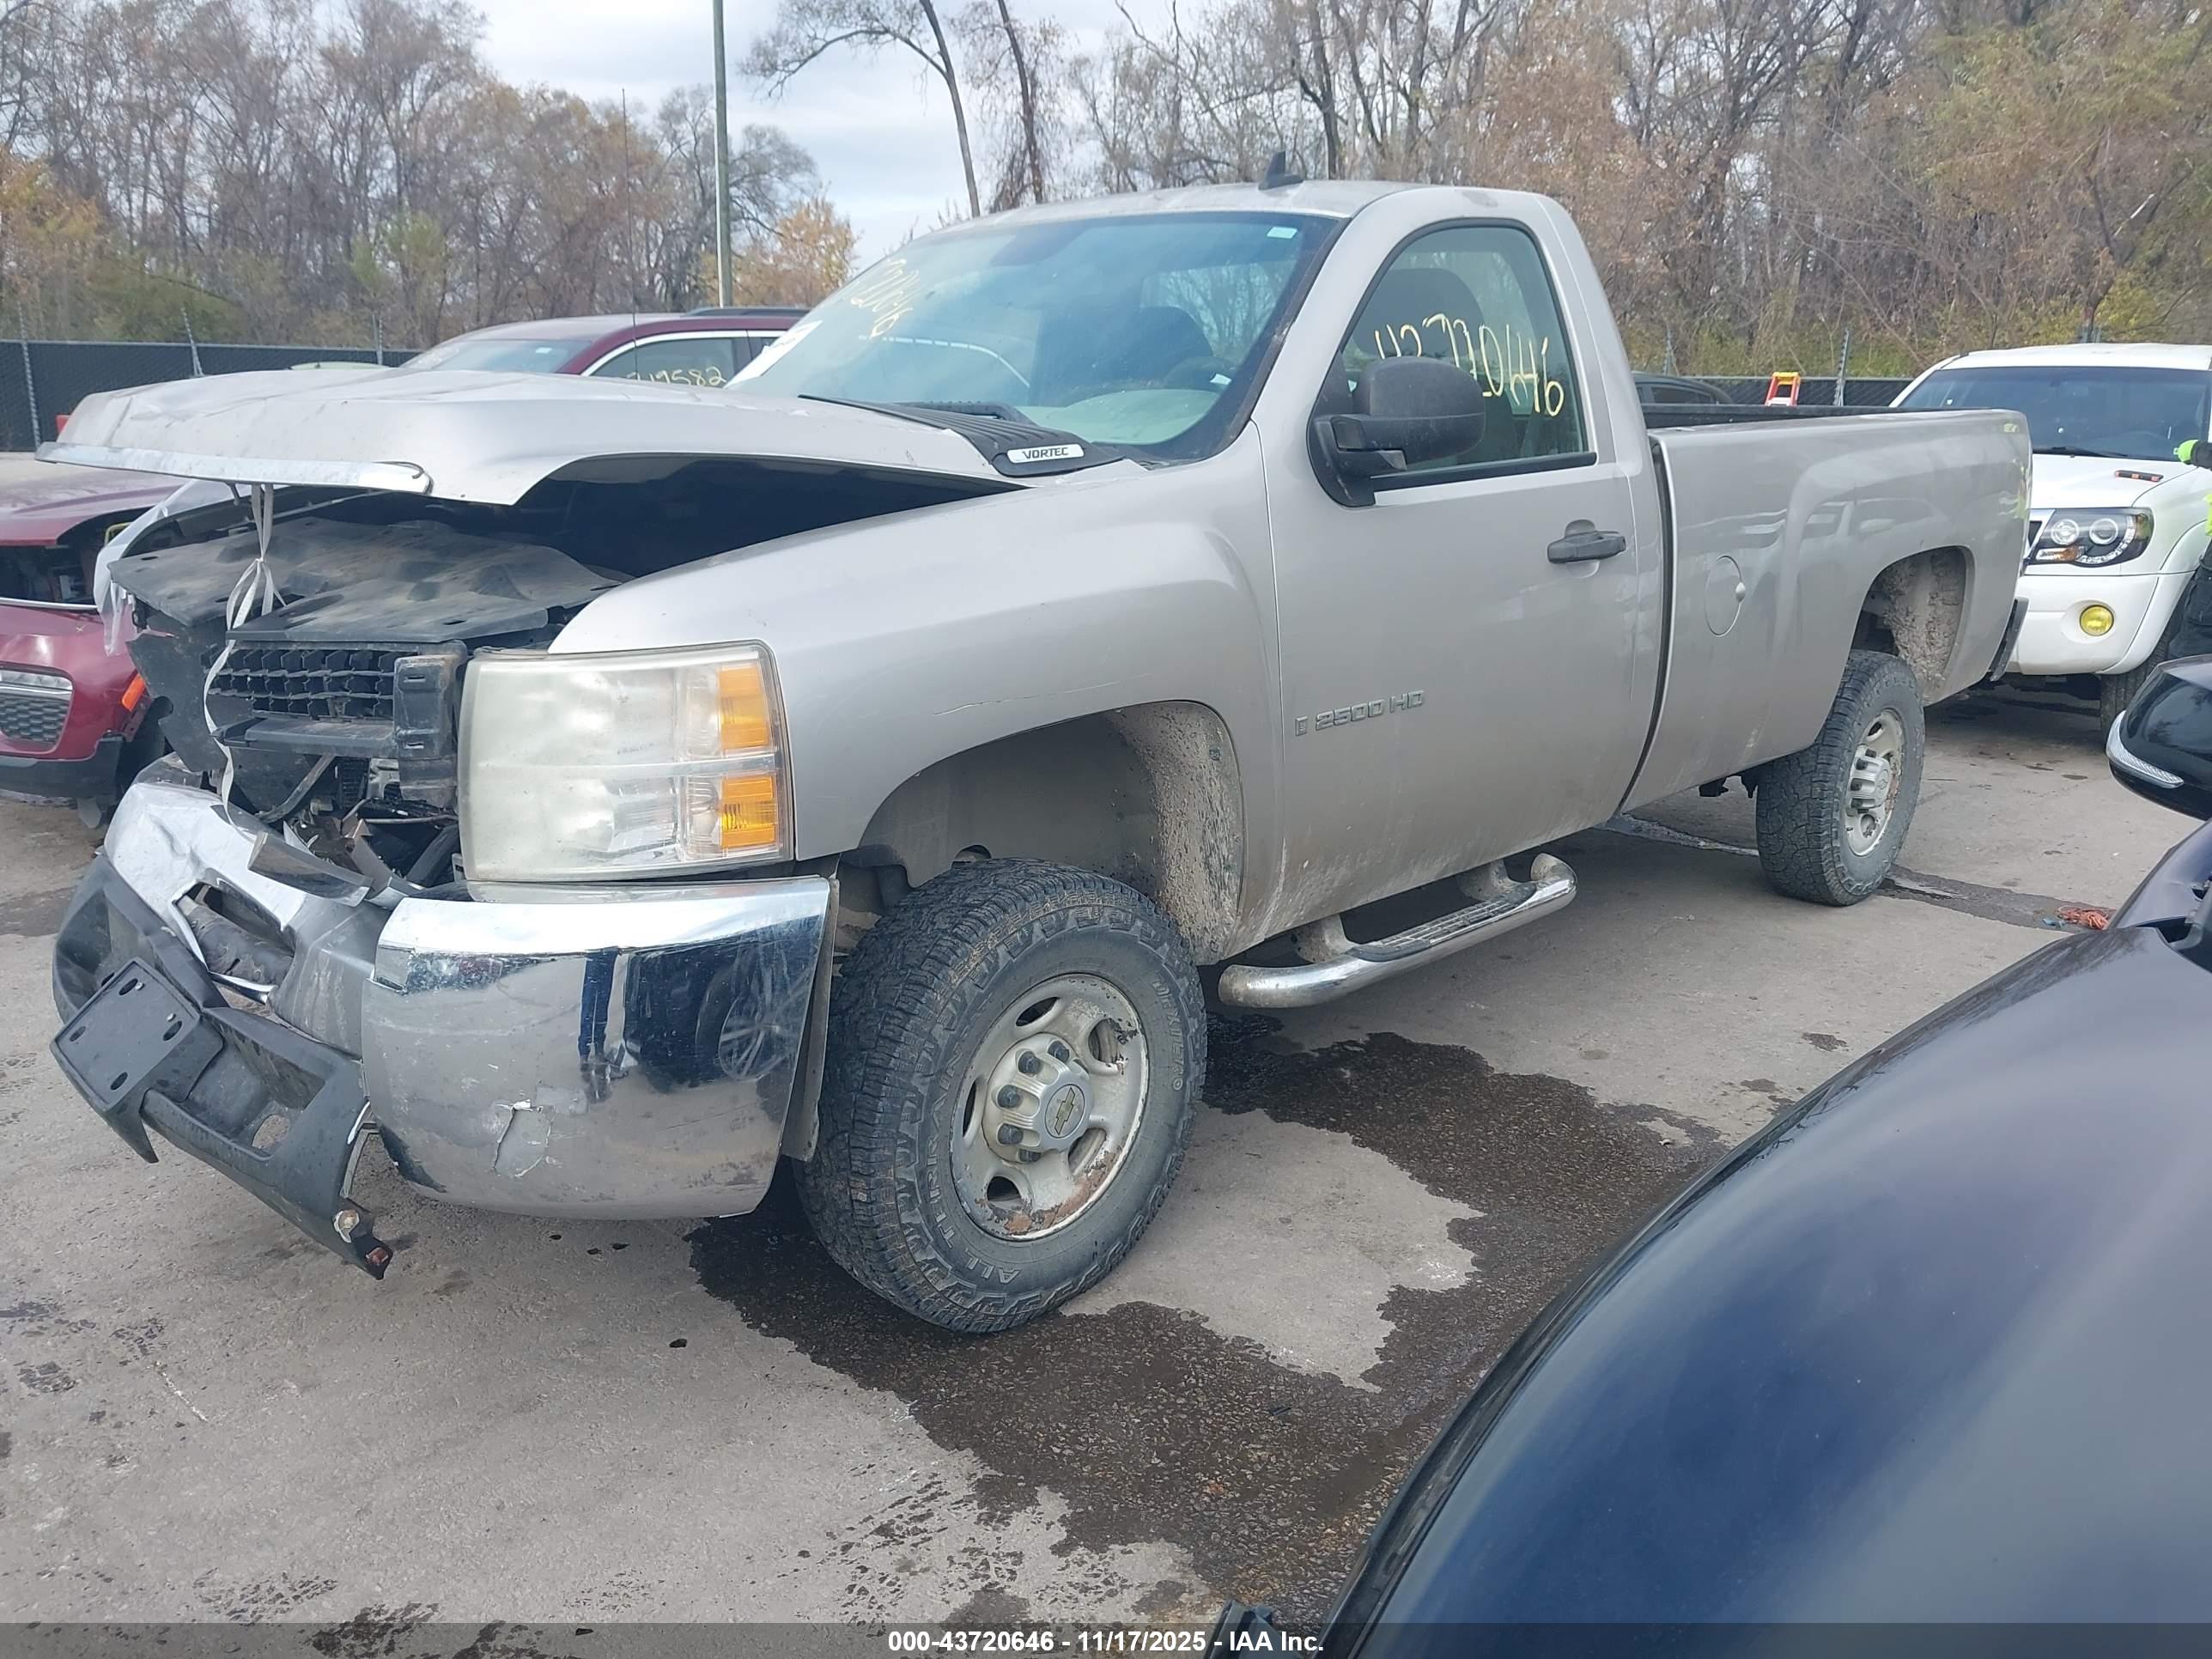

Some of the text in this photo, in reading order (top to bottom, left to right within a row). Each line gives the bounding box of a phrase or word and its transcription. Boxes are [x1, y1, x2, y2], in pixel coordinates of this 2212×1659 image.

[1022, 447, 1069, 459] VORTEC
[1316, 690, 1425, 731] 2500 HD
[964, 1248, 1022, 1285] ALL
